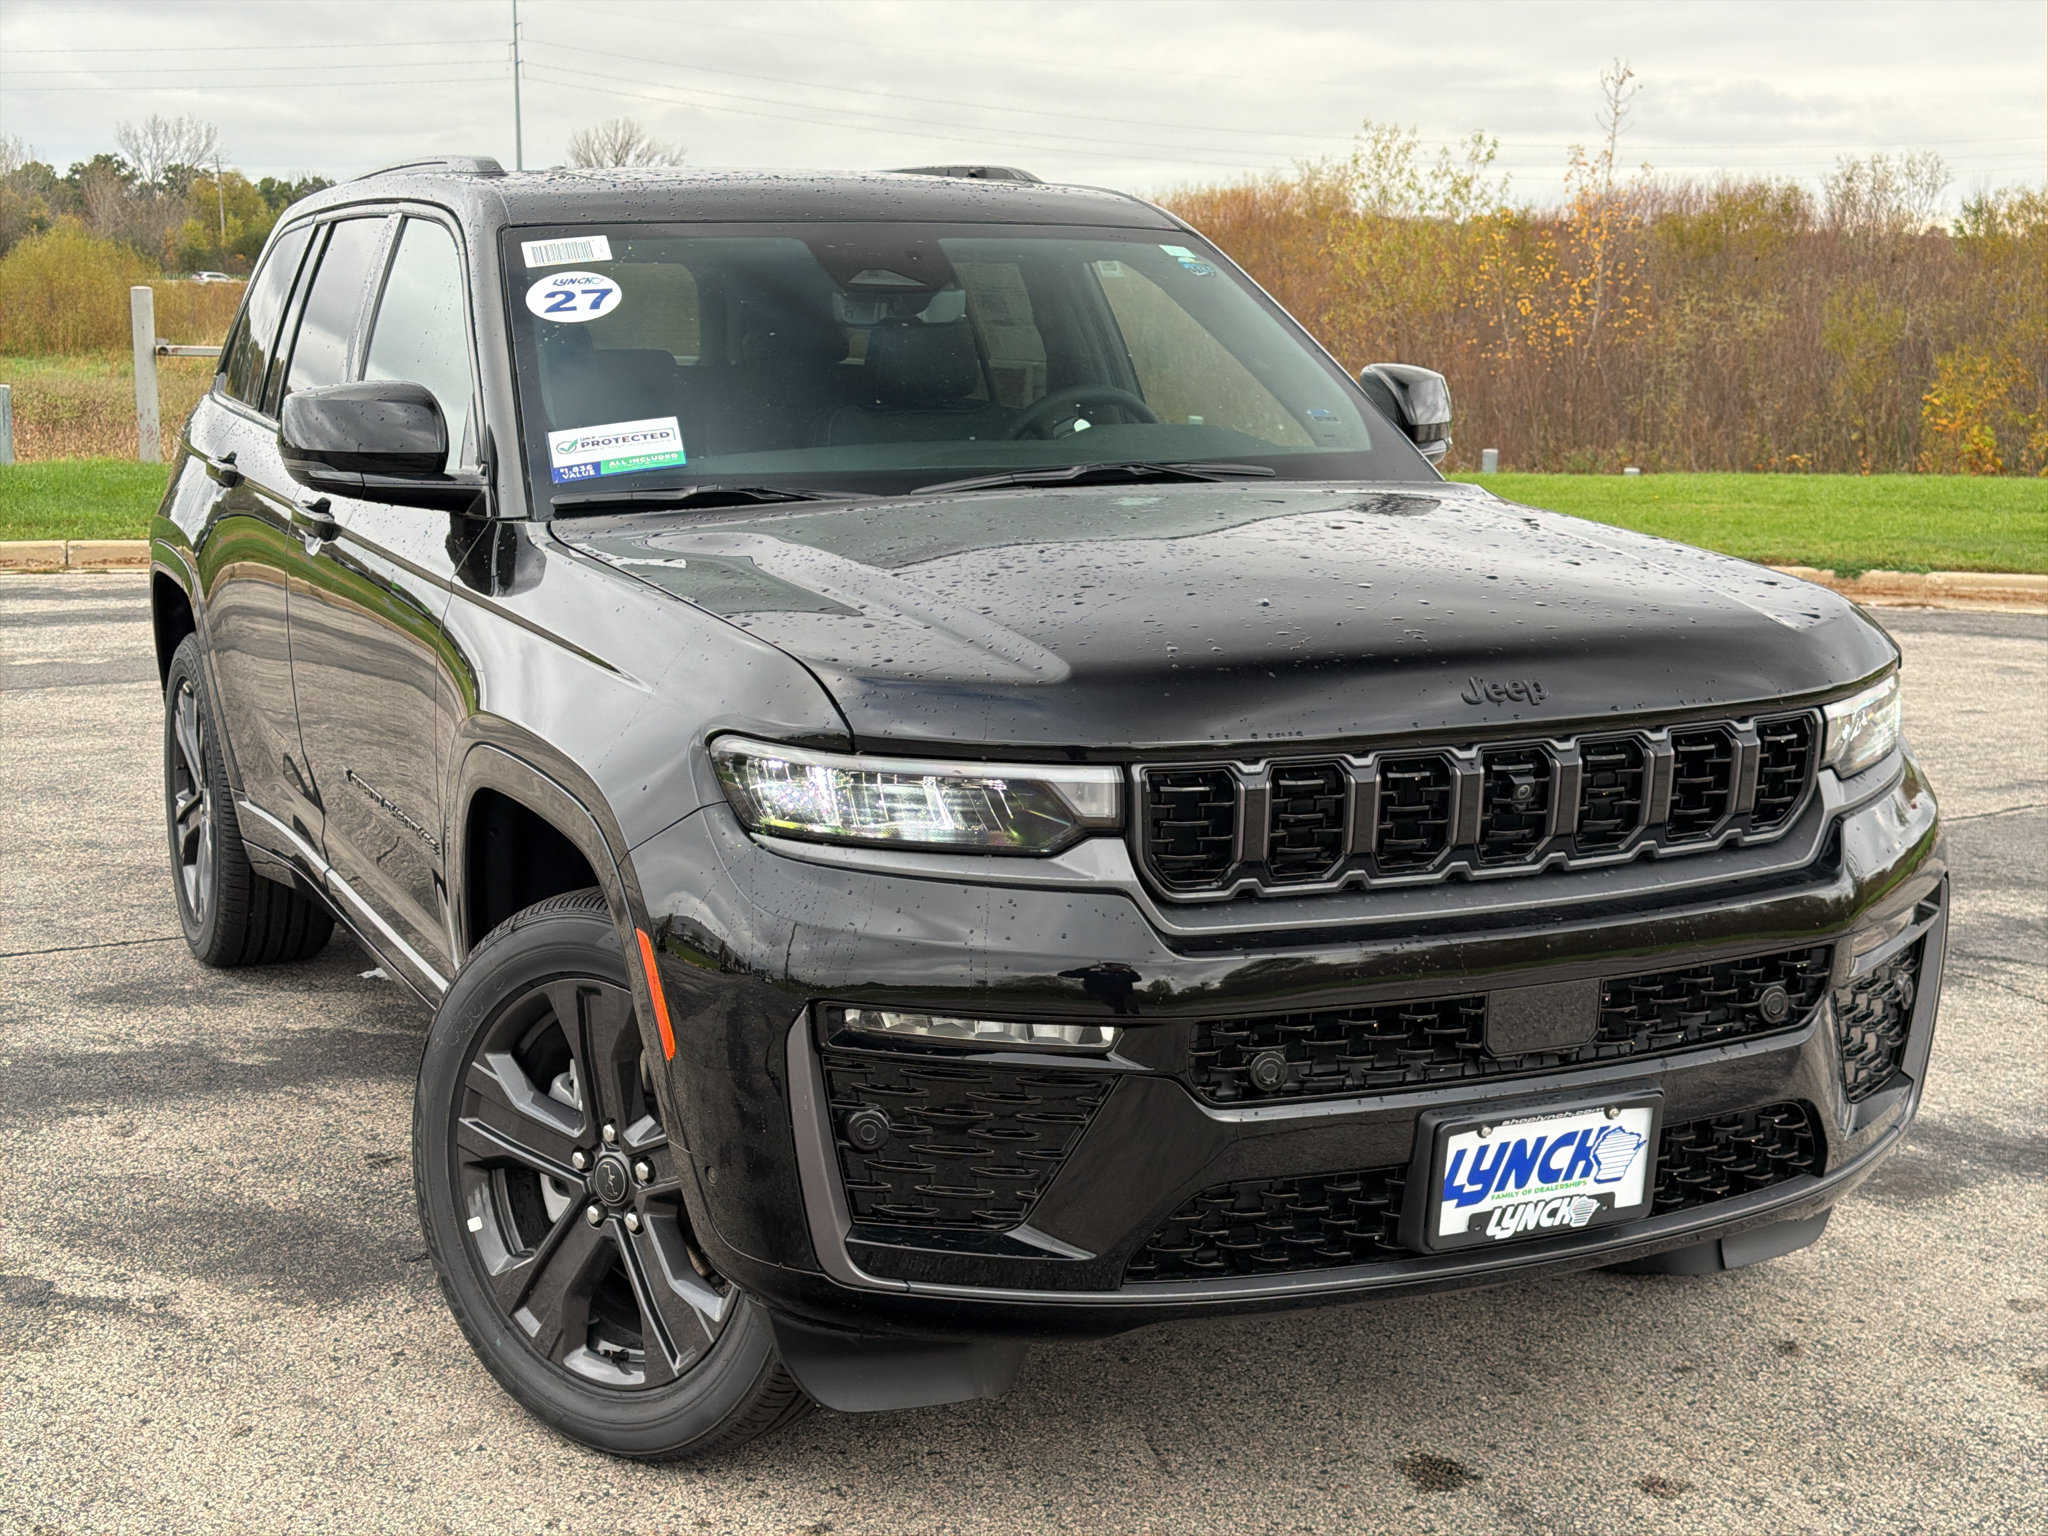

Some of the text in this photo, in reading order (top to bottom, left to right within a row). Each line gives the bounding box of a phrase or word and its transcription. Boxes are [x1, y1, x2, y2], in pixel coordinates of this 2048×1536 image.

[543, 288, 613, 314] 27
[580, 431, 671, 448] PROTECTED
[608, 459, 627, 468] ALL
[629, 453, 678, 464] INCLUDED
[562, 470, 596, 480] VALUE
[1461, 676, 1549, 706] Jeep
[1443, 1125, 1611, 1208] LYNCH
[1491, 1180, 1588, 1201] FAMILY OF DEALERSHIPS
[1486, 1194, 1577, 1239] LYNCH
